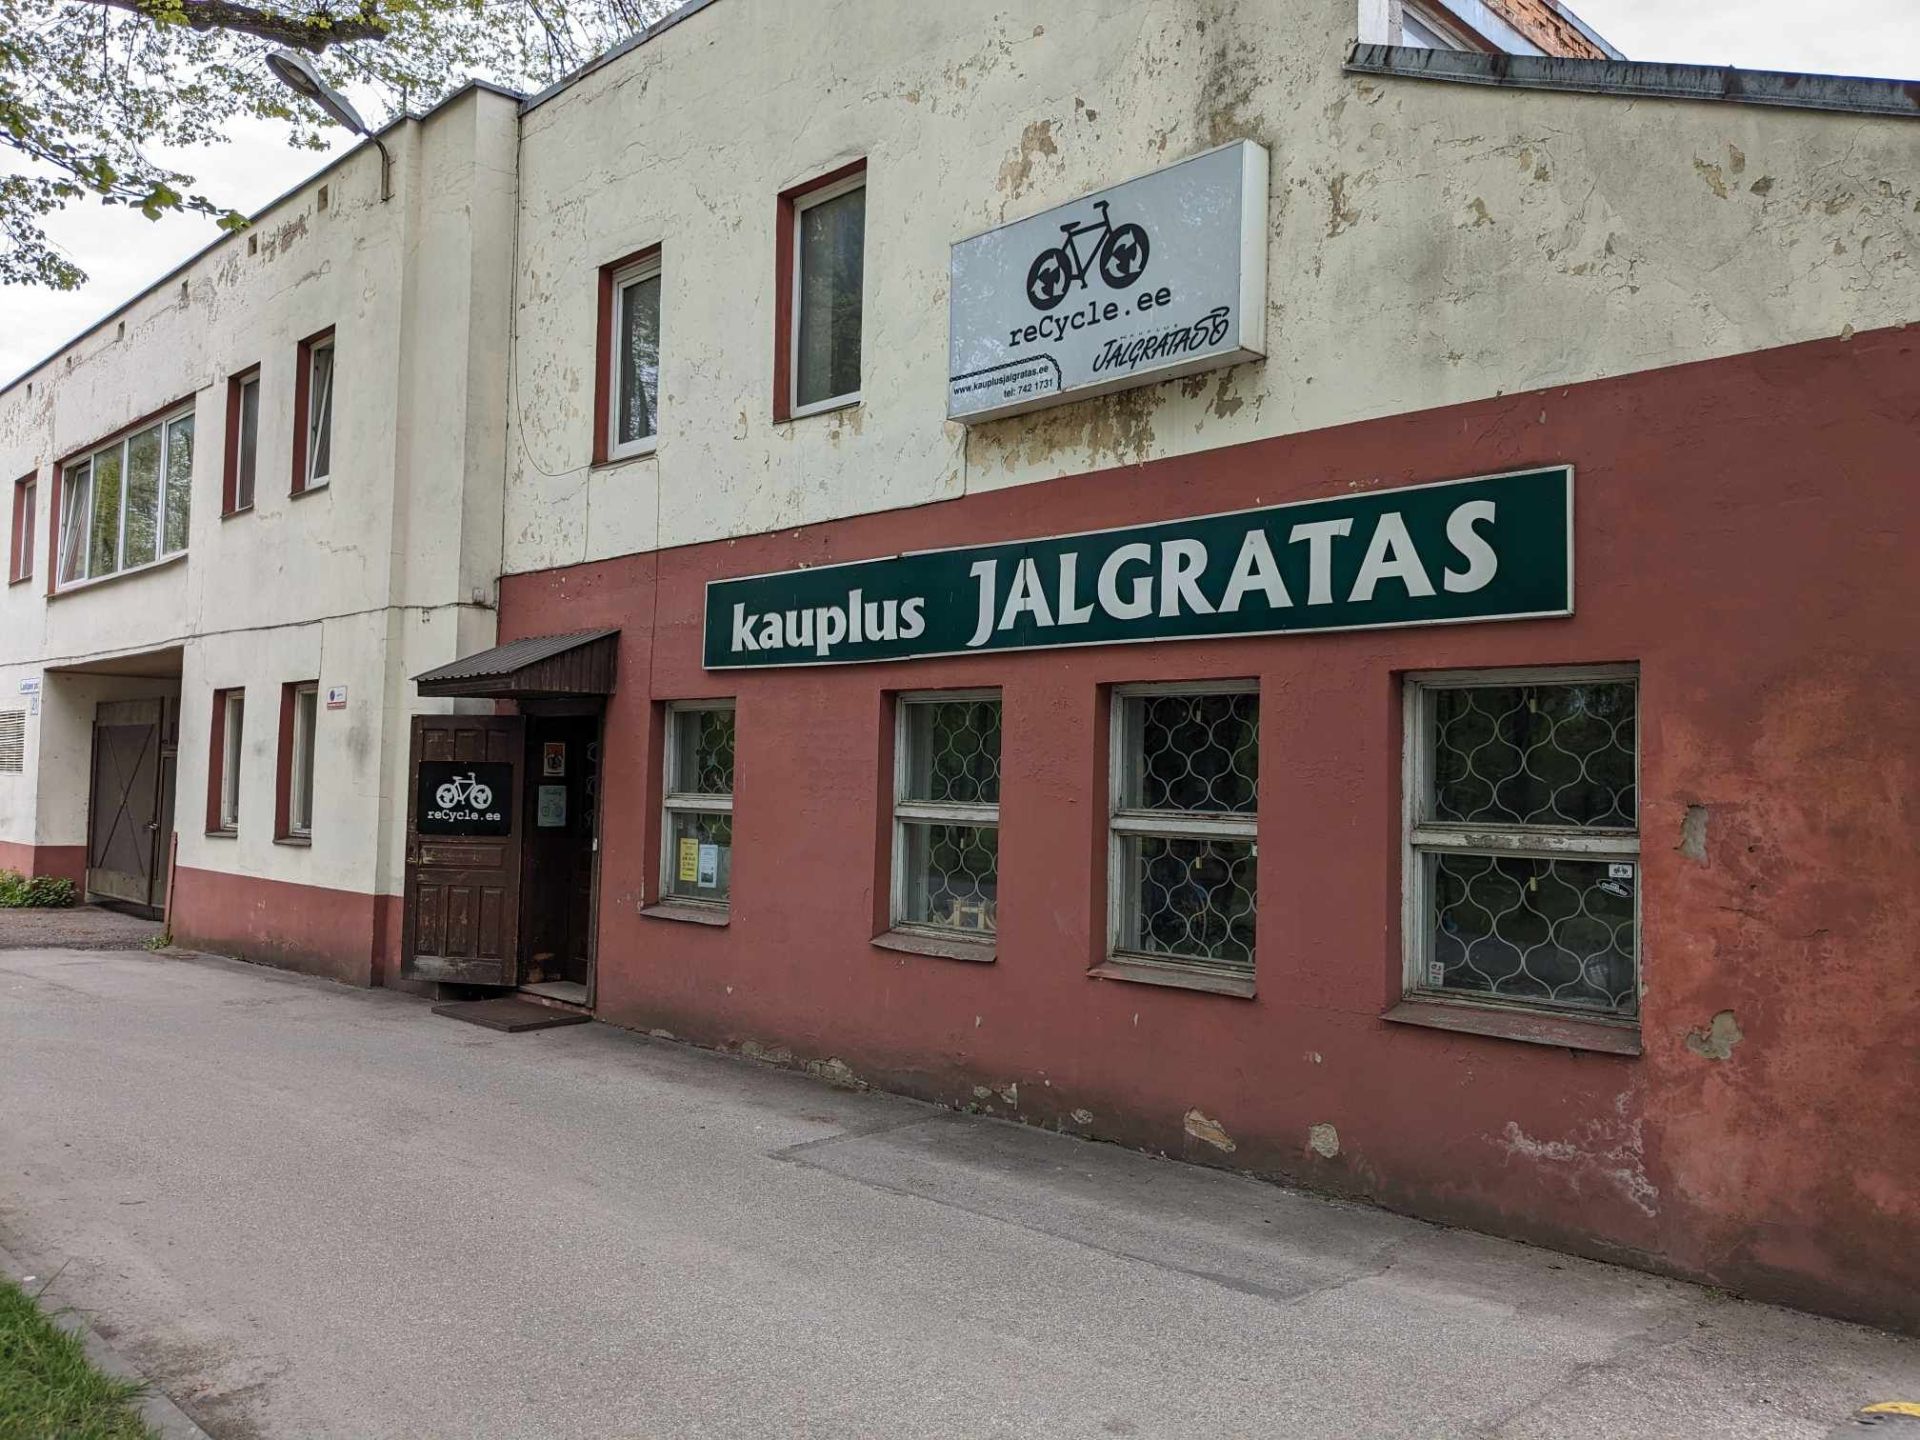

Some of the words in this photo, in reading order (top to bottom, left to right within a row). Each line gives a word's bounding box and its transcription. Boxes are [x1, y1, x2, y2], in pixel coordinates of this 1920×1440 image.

[1009, 287, 1171, 347] reCycle.ee
[953, 365, 1049, 395] www.kauplusjalgratas.ee
[1003, 387, 1016, 398] tel:
[1018, 383, 1032, 395] 742
[1035, 378, 1053, 390] 1731
[731, 588, 926, 656] kauplus
[965, 500, 1499, 647] JALGRATAS
[427, 809, 501, 822] reCycle.ee
